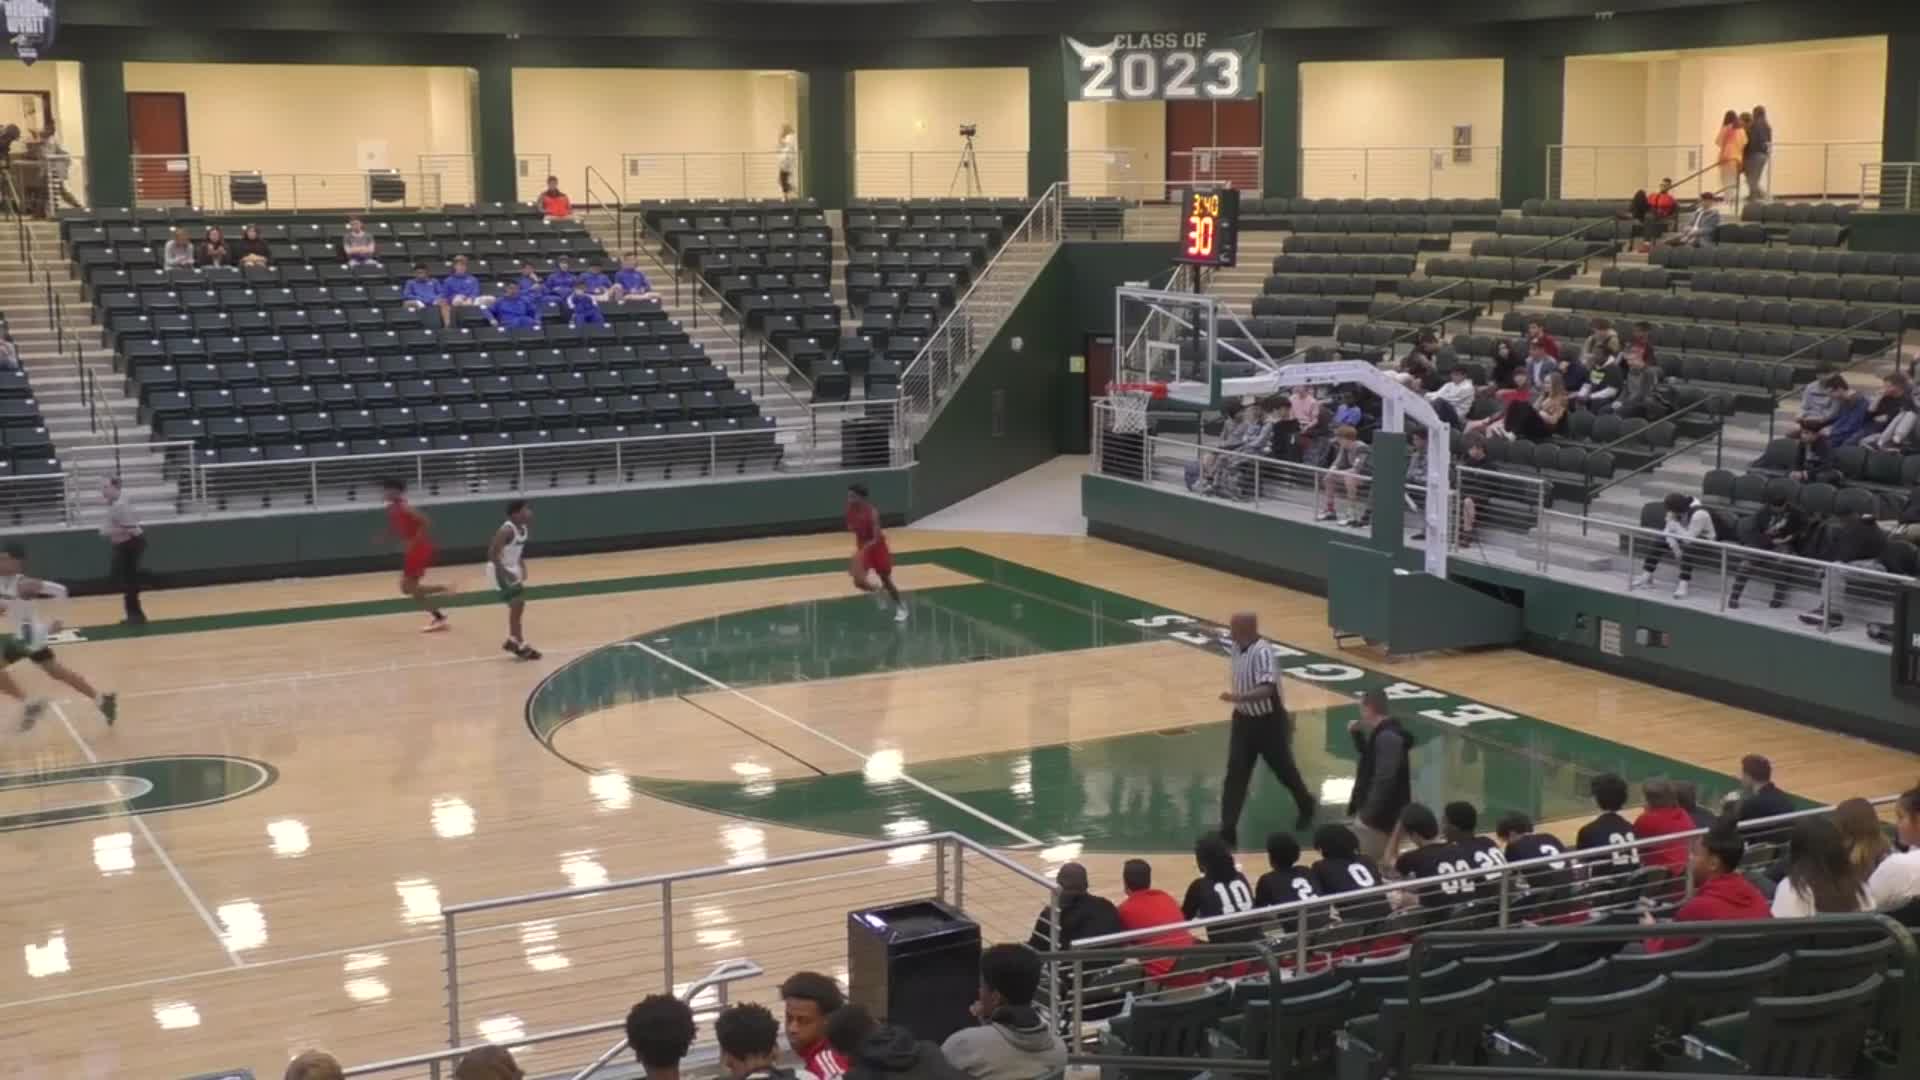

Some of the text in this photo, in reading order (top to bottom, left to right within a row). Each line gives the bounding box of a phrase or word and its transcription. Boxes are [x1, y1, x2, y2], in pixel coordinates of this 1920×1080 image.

[1115, 32, 1208, 50] CLASS OF
[1080, 50, 1242, 98] 2023
[1192, 193, 1219, 216] 3:40
[1188, 216, 1213, 256] 30
[1609, 832, 1641, 865] 21
[1347, 863, 1375, 888] 0
[1213, 879, 1254, 915] 10
